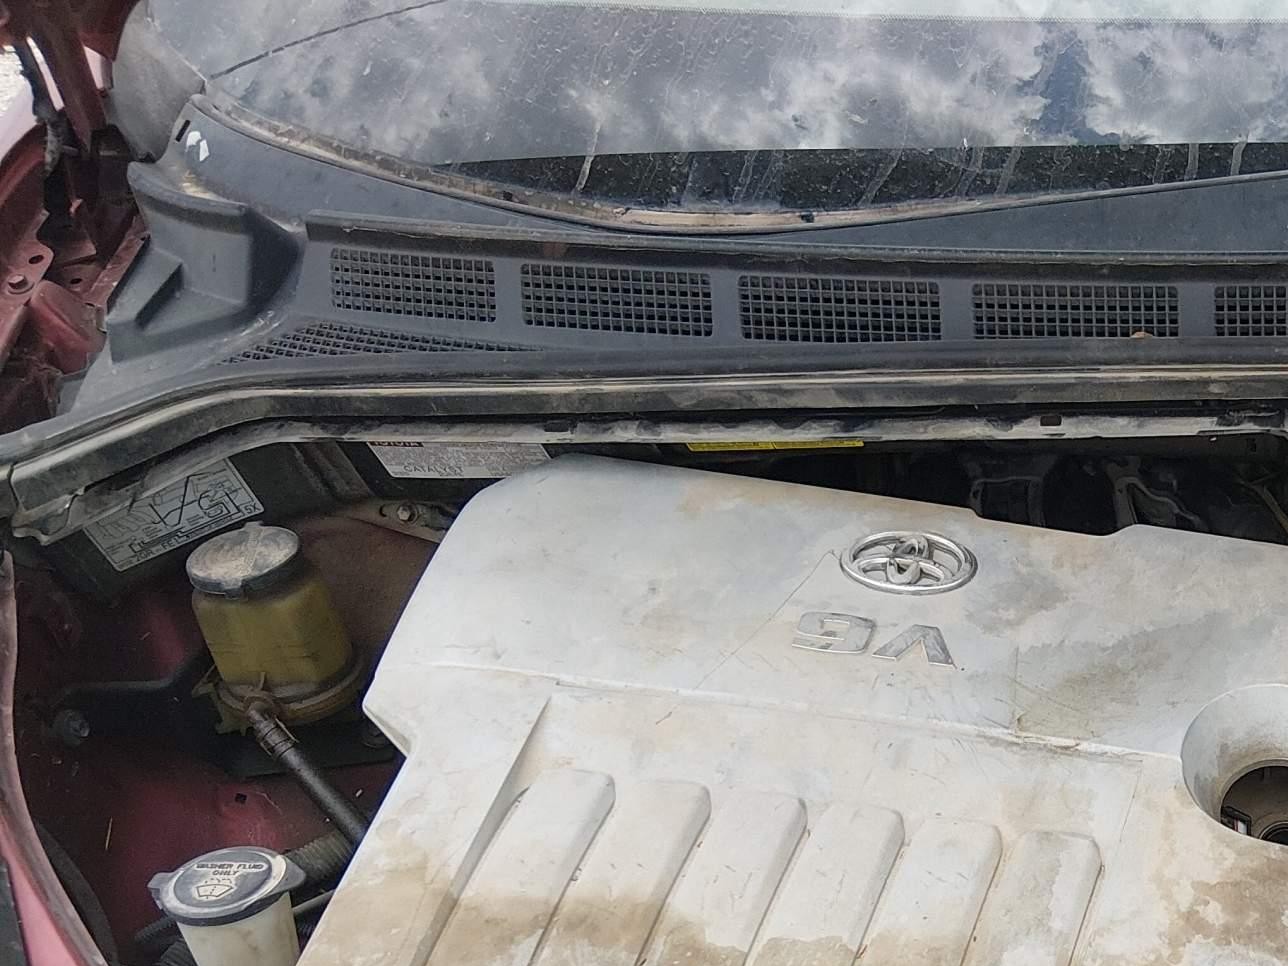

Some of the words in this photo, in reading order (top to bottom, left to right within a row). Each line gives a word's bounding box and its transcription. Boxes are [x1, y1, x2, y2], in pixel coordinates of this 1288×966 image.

[402, 464, 464, 474] CATALYST
[242, 502, 261, 516] 5X
[791, 610, 958, 668] V6
[196, 862, 233, 870] WASHER
